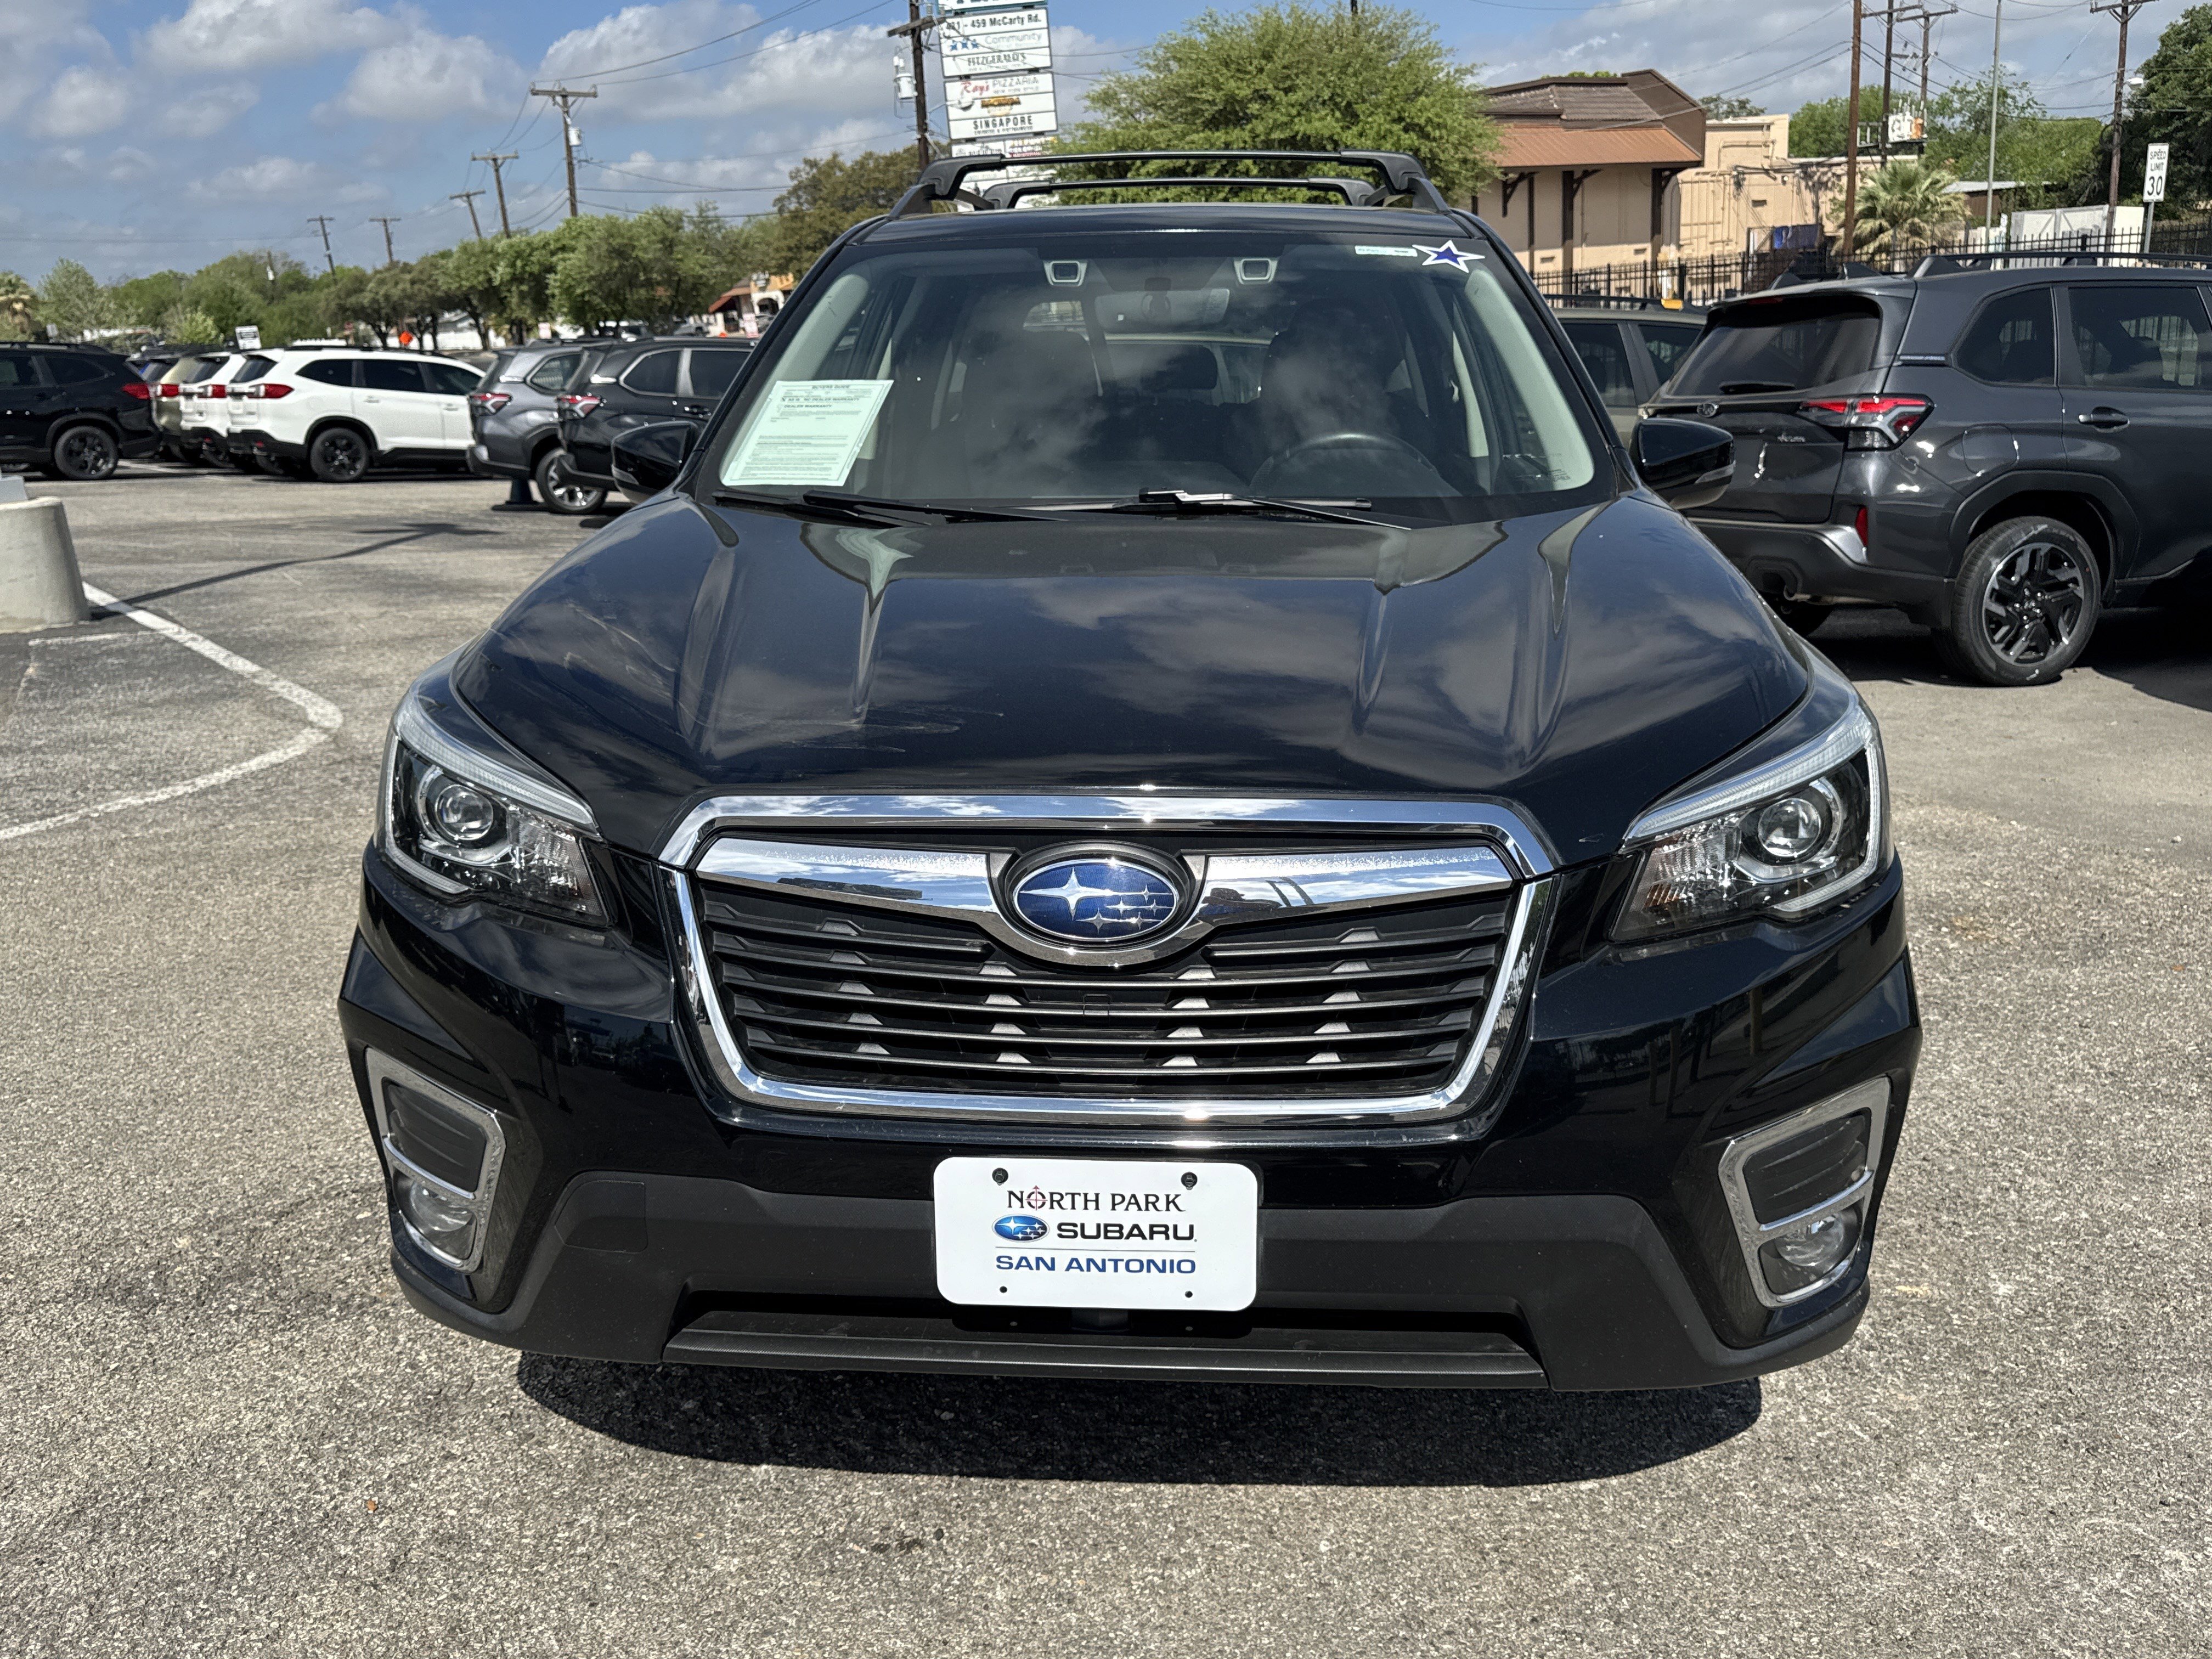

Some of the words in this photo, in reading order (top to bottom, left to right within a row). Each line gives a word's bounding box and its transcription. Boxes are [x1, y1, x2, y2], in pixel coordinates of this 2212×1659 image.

[970, 19, 986, 28] 459
[989, 16, 1024, 26] McCarty
[1028, 14, 1042, 23] Rd.
[985, 32, 1042, 44] Community
[992, 77, 1039, 88] PIZZARIA
[973, 115, 1033, 130] SINGAPORE
[2150, 150, 2166, 160] SPEED
[2150, 162, 2164, 171] LIMIT
[2147, 176, 2163, 196] 30
[1007, 1186, 1100, 1211] NORTH
[1110, 1193, 1186, 1212] PARK
[1057, 1222, 1195, 1242] SUBARU
[996, 1255, 1056, 1272] SAN
[1064, 1257, 1197, 1274] ANTONIO
